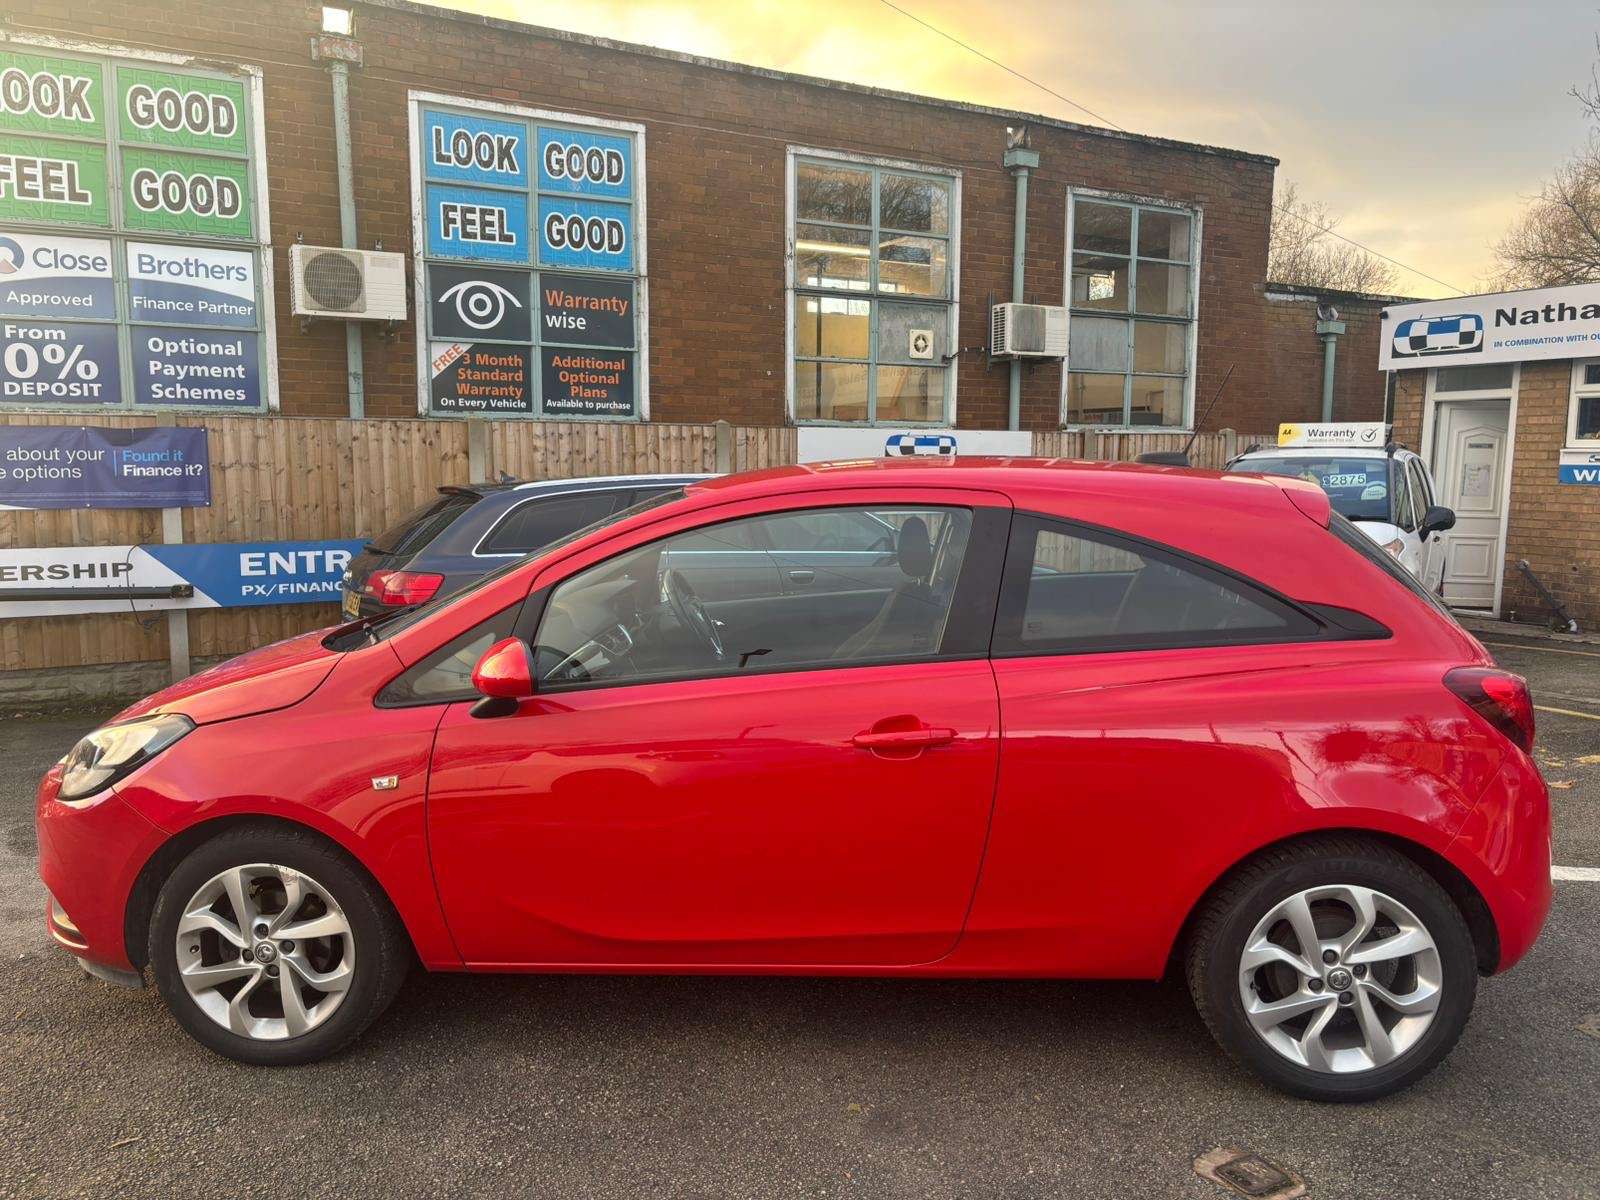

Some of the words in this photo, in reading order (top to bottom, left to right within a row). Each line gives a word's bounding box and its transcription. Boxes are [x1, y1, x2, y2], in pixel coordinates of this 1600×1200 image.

[0, 68, 94, 122] OOK
[127, 84, 237, 137] GOOD
[432, 126, 520, 174] LOOK
[545, 142, 624, 185] GOOD
[132, 168, 241, 218] GOOD
[441, 202, 516, 245] FEEL
[545, 212, 625, 254] GOOD
[33, 248, 107, 271] Close
[137, 254, 247, 281] Brothers
[7, 291, 92, 307] Approved
[133, 297, 193, 312] Finance
[199, 302, 253, 315] Partner
[546, 289, 628, 316] Warranty
[546, 312, 586, 330] wise
[1495, 303, 1600, 327] Natha
[5, 325, 66, 340] From
[1505, 336, 1563, 347] COMBINATION
[1566, 334, 1588, 343] WITH
[148, 337, 242, 357] Optional
[5, 342, 98, 380] 0%
[432, 343, 463, 372] FREE
[463, 353, 470, 364] 3
[476, 354, 523, 367] Month
[552, 356, 625, 370] Additional
[150, 361, 245, 381] Payment
[458, 369, 523, 382] Standard
[559, 371, 619, 385] Optional
[4, 382, 102, 397] DEPOSIT
[151, 384, 245, 400] Schemes
[457, 383, 523, 399] Warranty
[571, 385, 608, 398] Plans
[441, 398, 456, 407] On
[459, 398, 486, 409] Every
[490, 399, 526, 408] Vehicle
[546, 400, 583, 408] Available
[585, 401, 594, 409] to
[596, 402, 631, 411] purchase
[1307, 428, 1357, 438] Warranty
[7, 447, 60, 461] about
[66, 450, 104, 463] your
[123, 451, 170, 462] Found
[172, 450, 183, 462] it
[13, 464, 81, 481] options
[123, 464, 182, 476] Finance
[185, 464, 203, 476] it?
[240, 550, 352, 576] ENTR
[0, 562, 134, 581] ERSHIP
[241, 581, 343, 597] PX/FINANC
